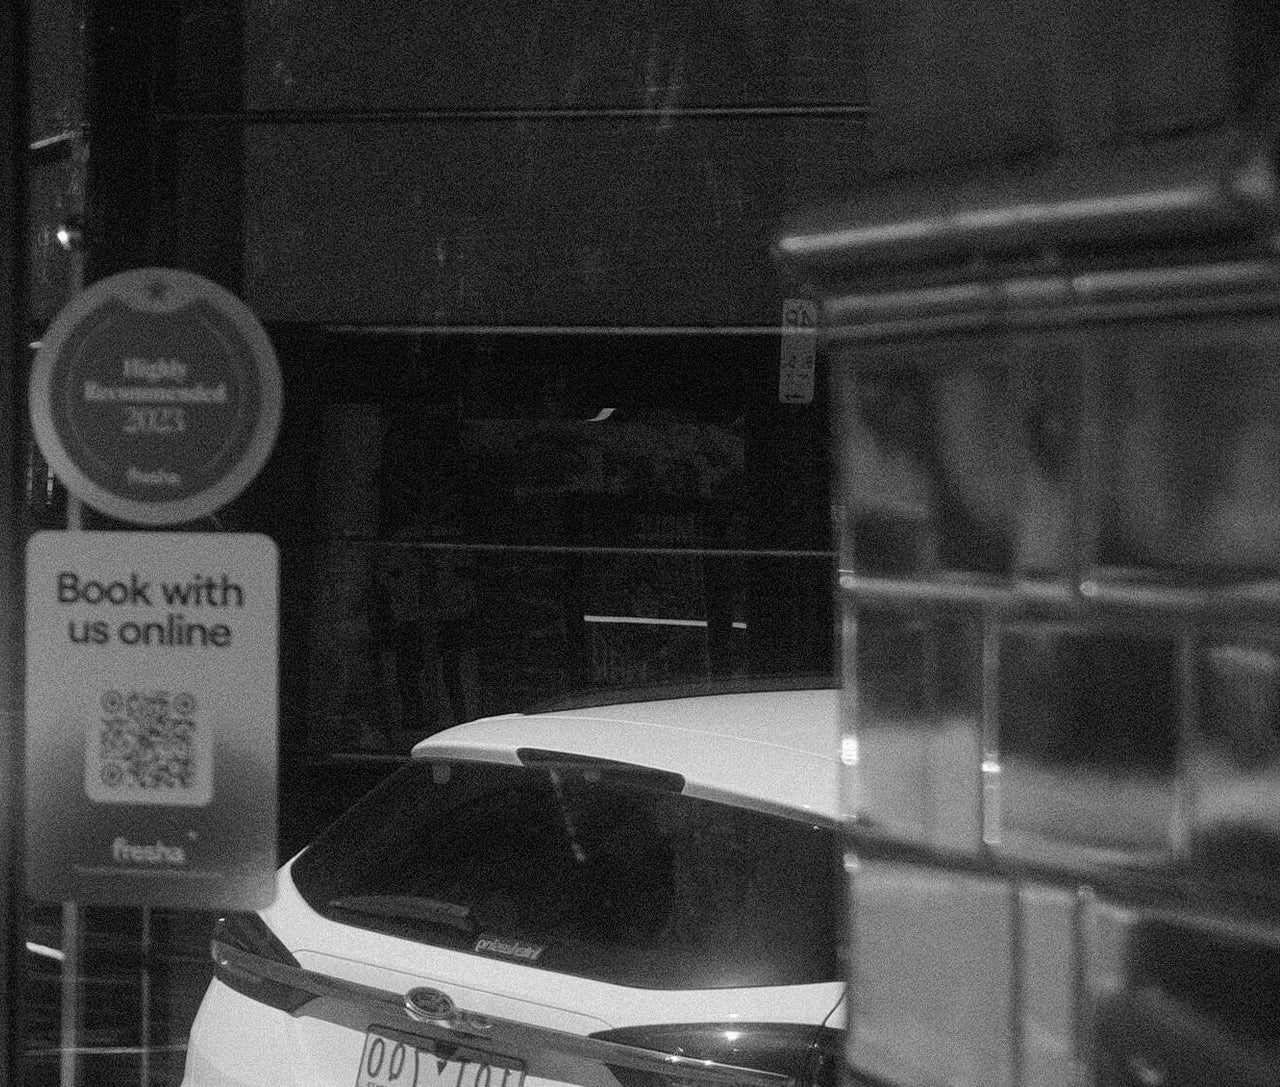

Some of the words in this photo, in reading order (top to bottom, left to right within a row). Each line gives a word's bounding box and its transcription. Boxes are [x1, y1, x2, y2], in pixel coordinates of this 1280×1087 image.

[56, 571, 153, 606] Book
[161, 573, 244, 607] with
[68, 619, 109, 646] us
[118, 614, 232, 647] online
[111, 836, 186, 865] fresha
